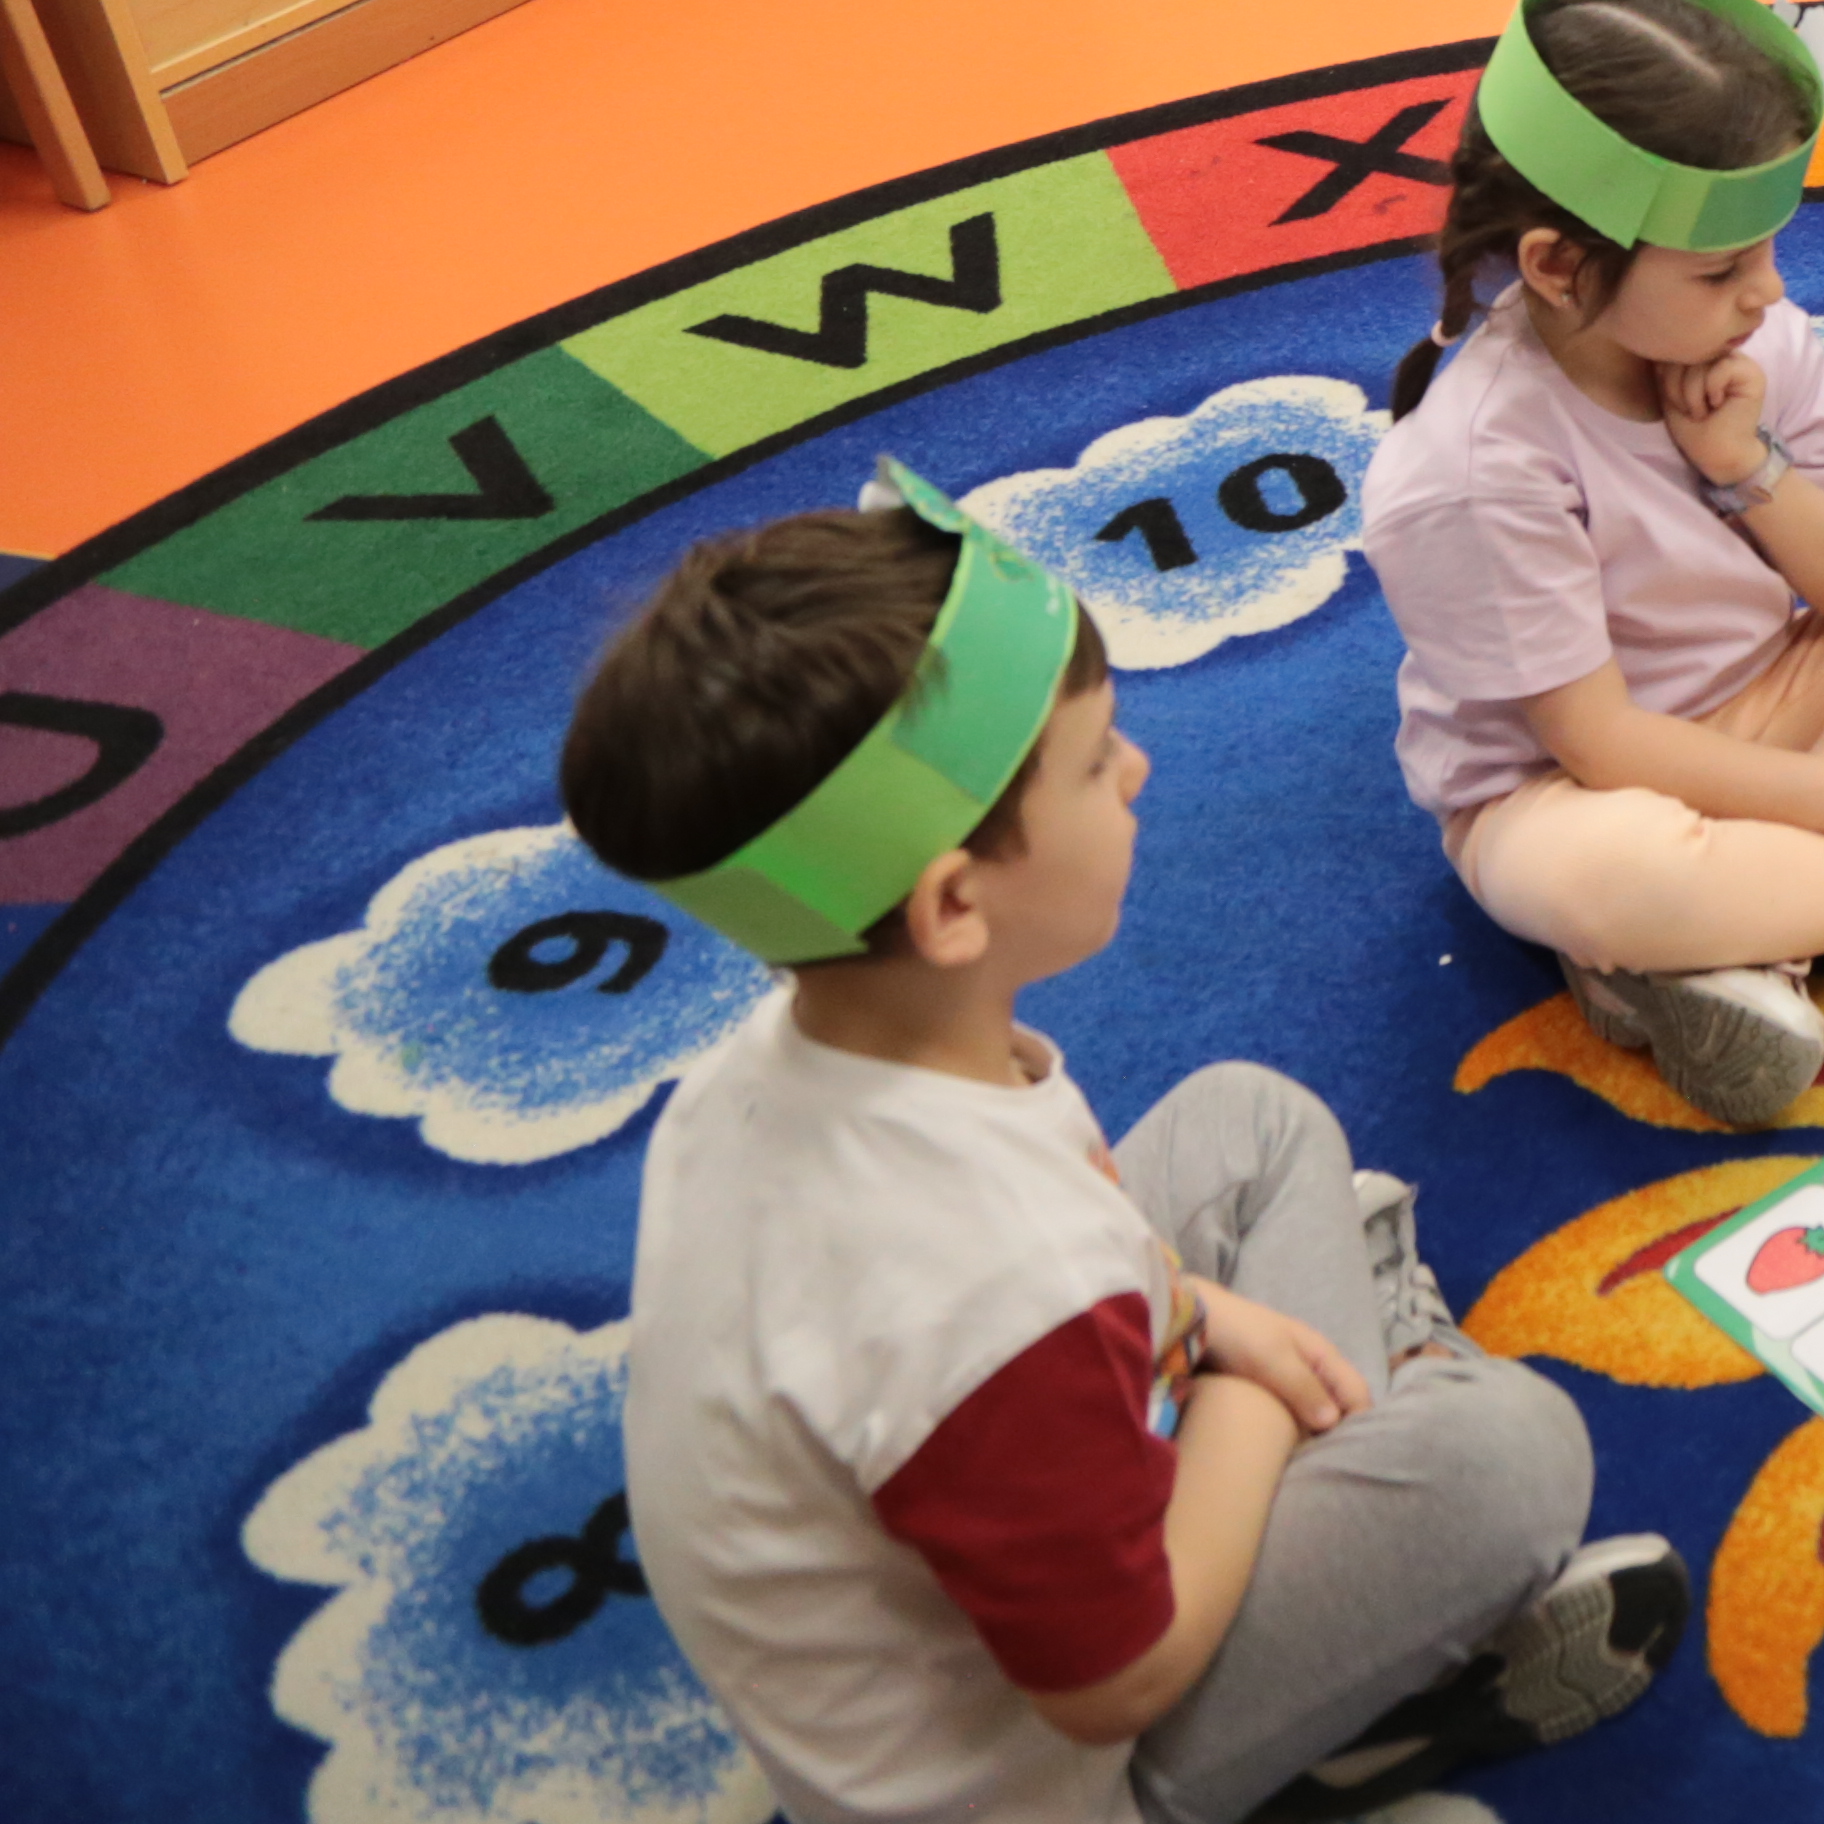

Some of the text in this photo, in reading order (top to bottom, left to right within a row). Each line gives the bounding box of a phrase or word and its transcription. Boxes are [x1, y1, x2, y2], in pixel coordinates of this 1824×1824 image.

[1253, 98, 1460, 228] X
[682, 210, 1004, 370] W
[301, 415, 556, 524] V
[1093, 450, 1349, 575] 10
